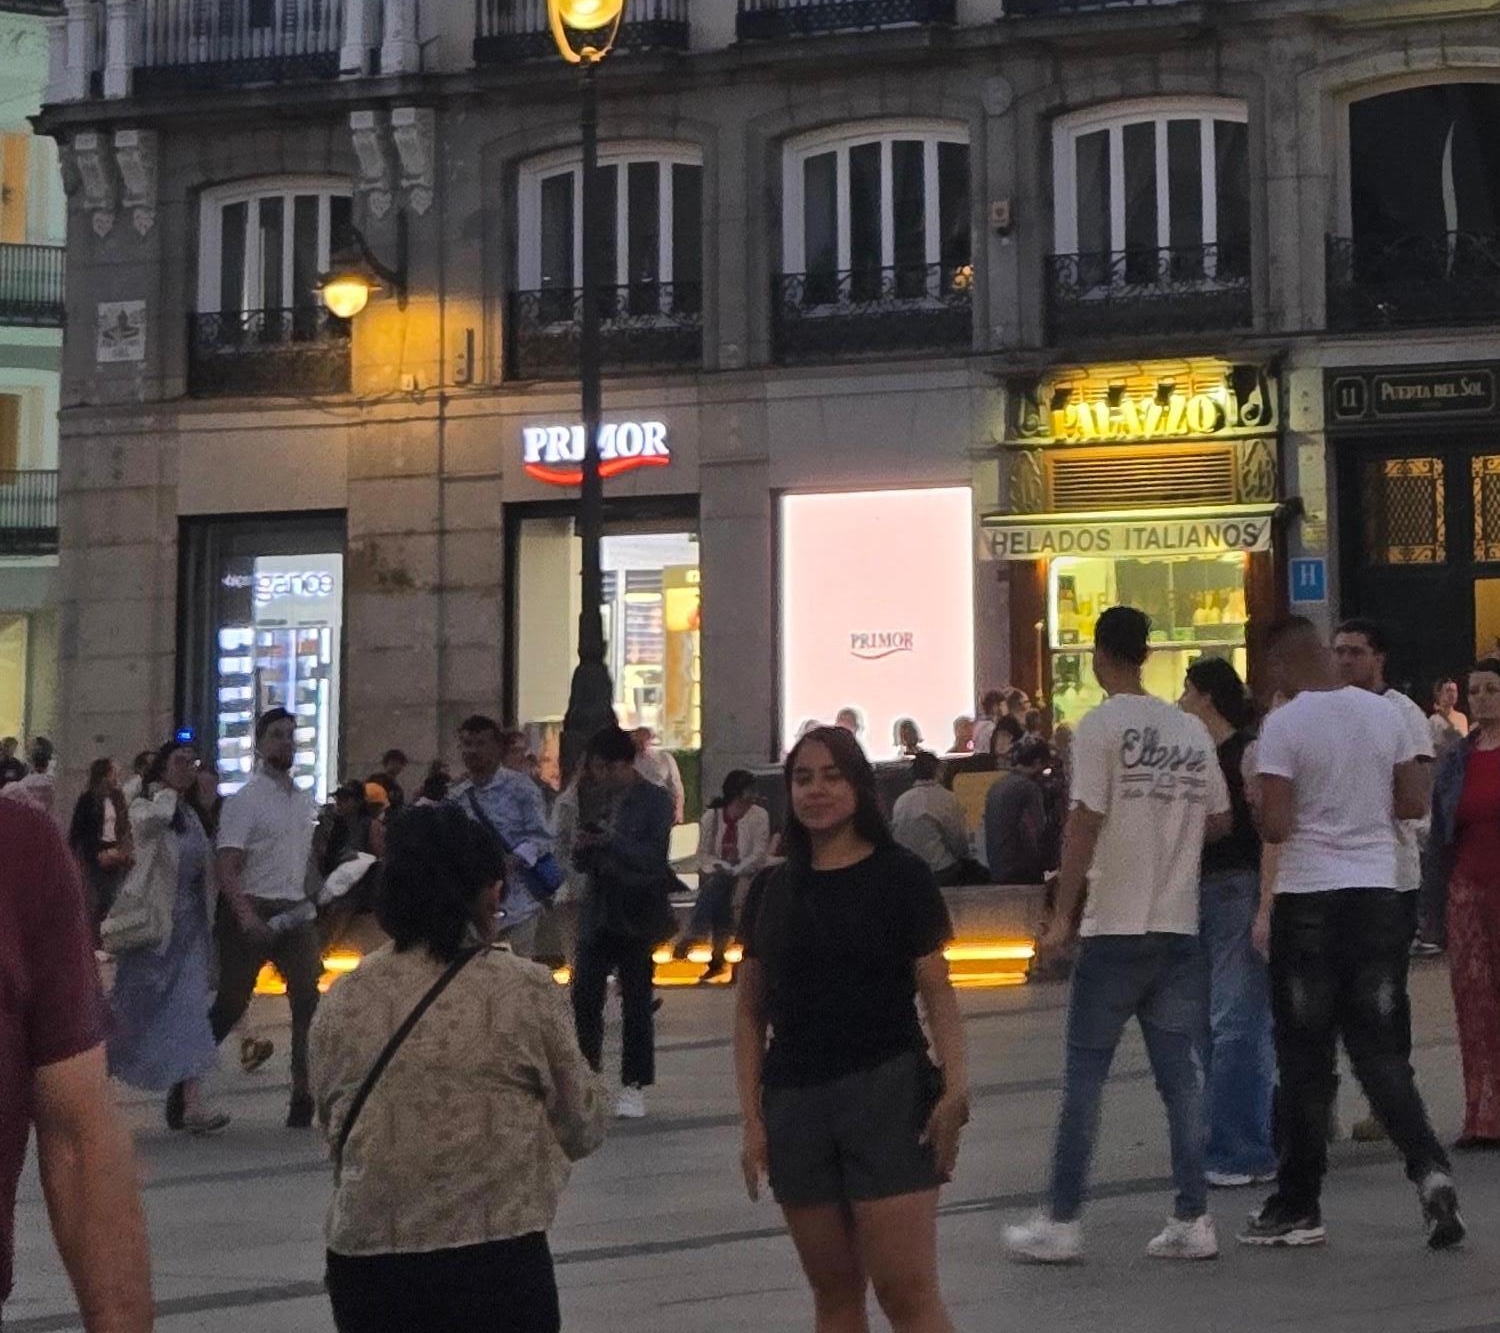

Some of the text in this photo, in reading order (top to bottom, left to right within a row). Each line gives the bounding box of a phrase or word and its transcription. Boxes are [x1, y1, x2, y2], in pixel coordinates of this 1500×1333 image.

[1342, 387, 1356, 407] 11
[1381, 382, 1431, 400] PUERTA
[1434, 383, 1457, 398] DEL
[991, 523, 1261, 558] HELADOS ITALIANOS
[1301, 564, 1316, 586] H
[850, 632, 914, 650] PRIMOR
